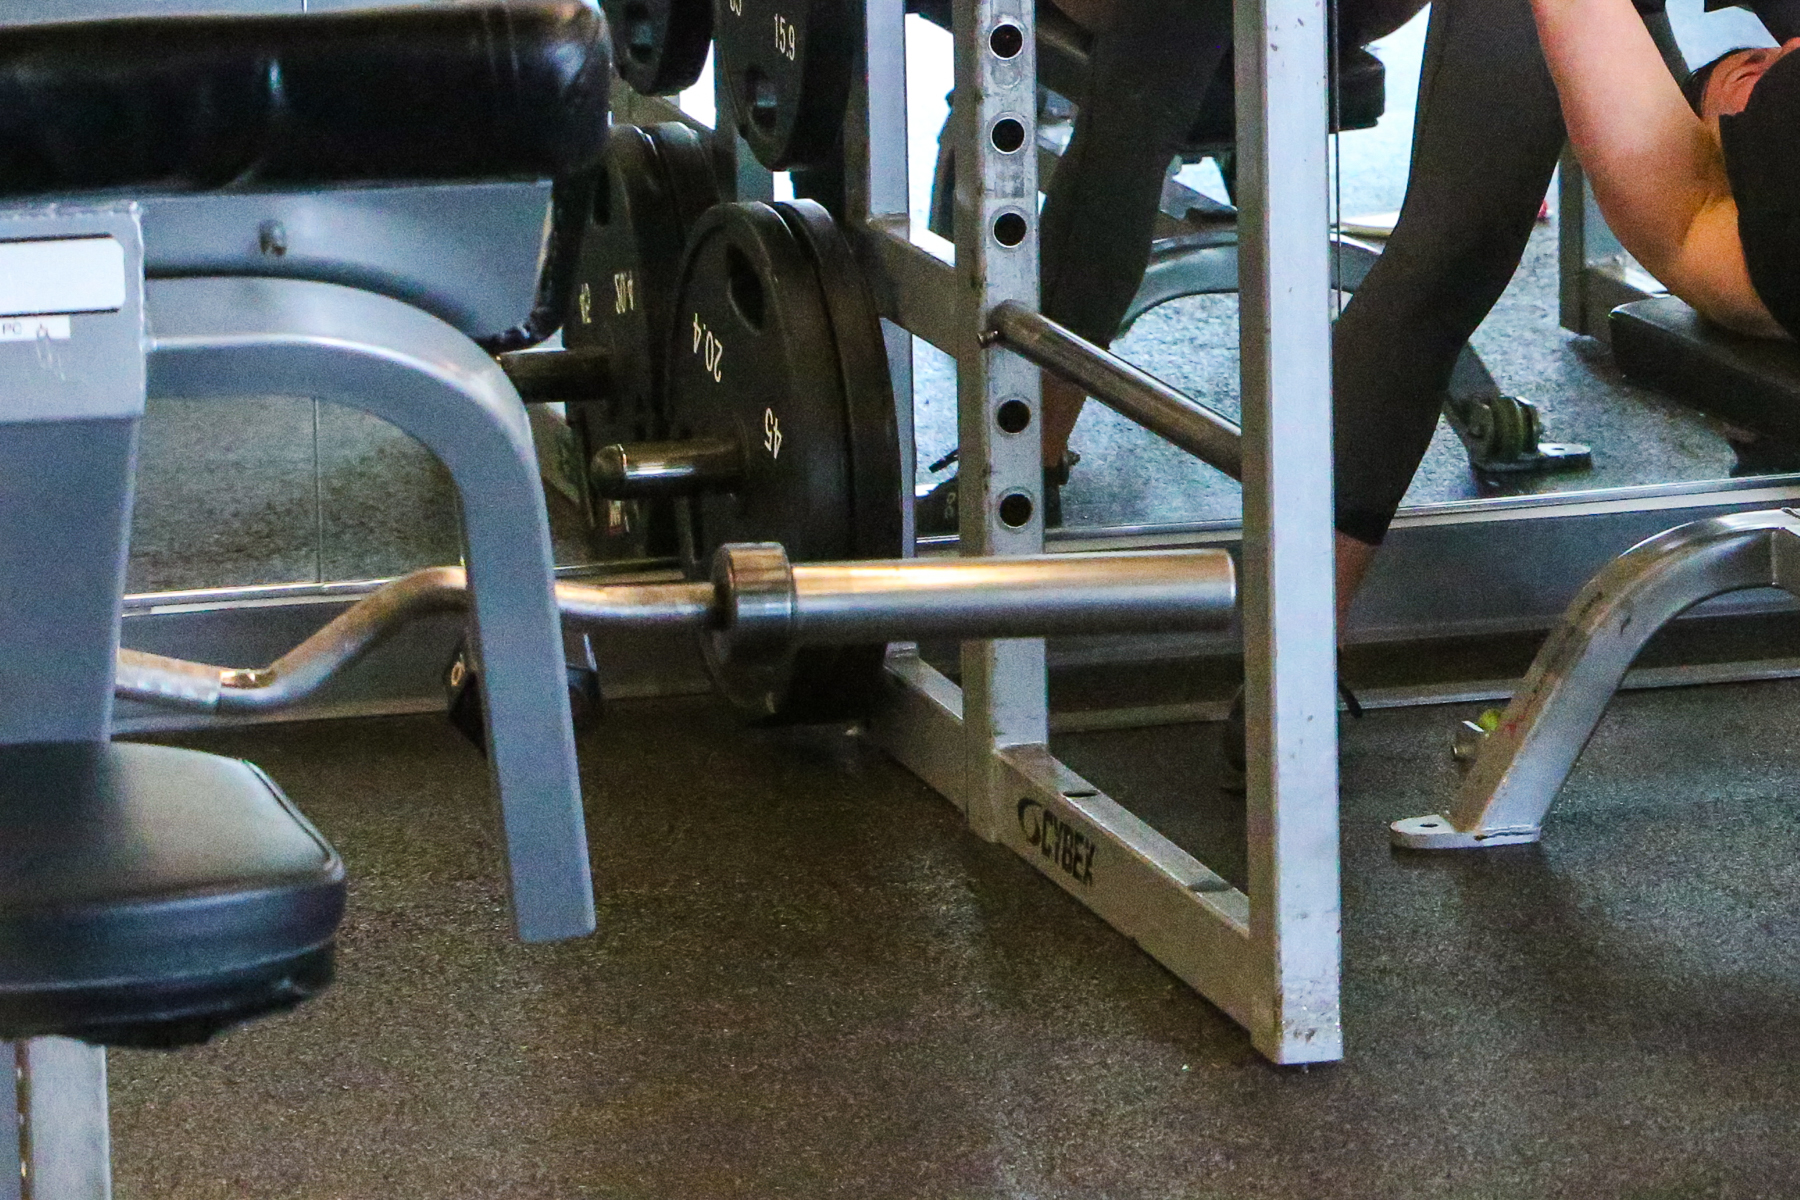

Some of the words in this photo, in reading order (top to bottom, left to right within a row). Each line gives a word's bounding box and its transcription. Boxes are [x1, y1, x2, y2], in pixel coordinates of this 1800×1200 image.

[773, 12, 797, 62] 15.9
[764, 407, 782, 460] 45
[1041, 809, 1096, 888] CYBEX
